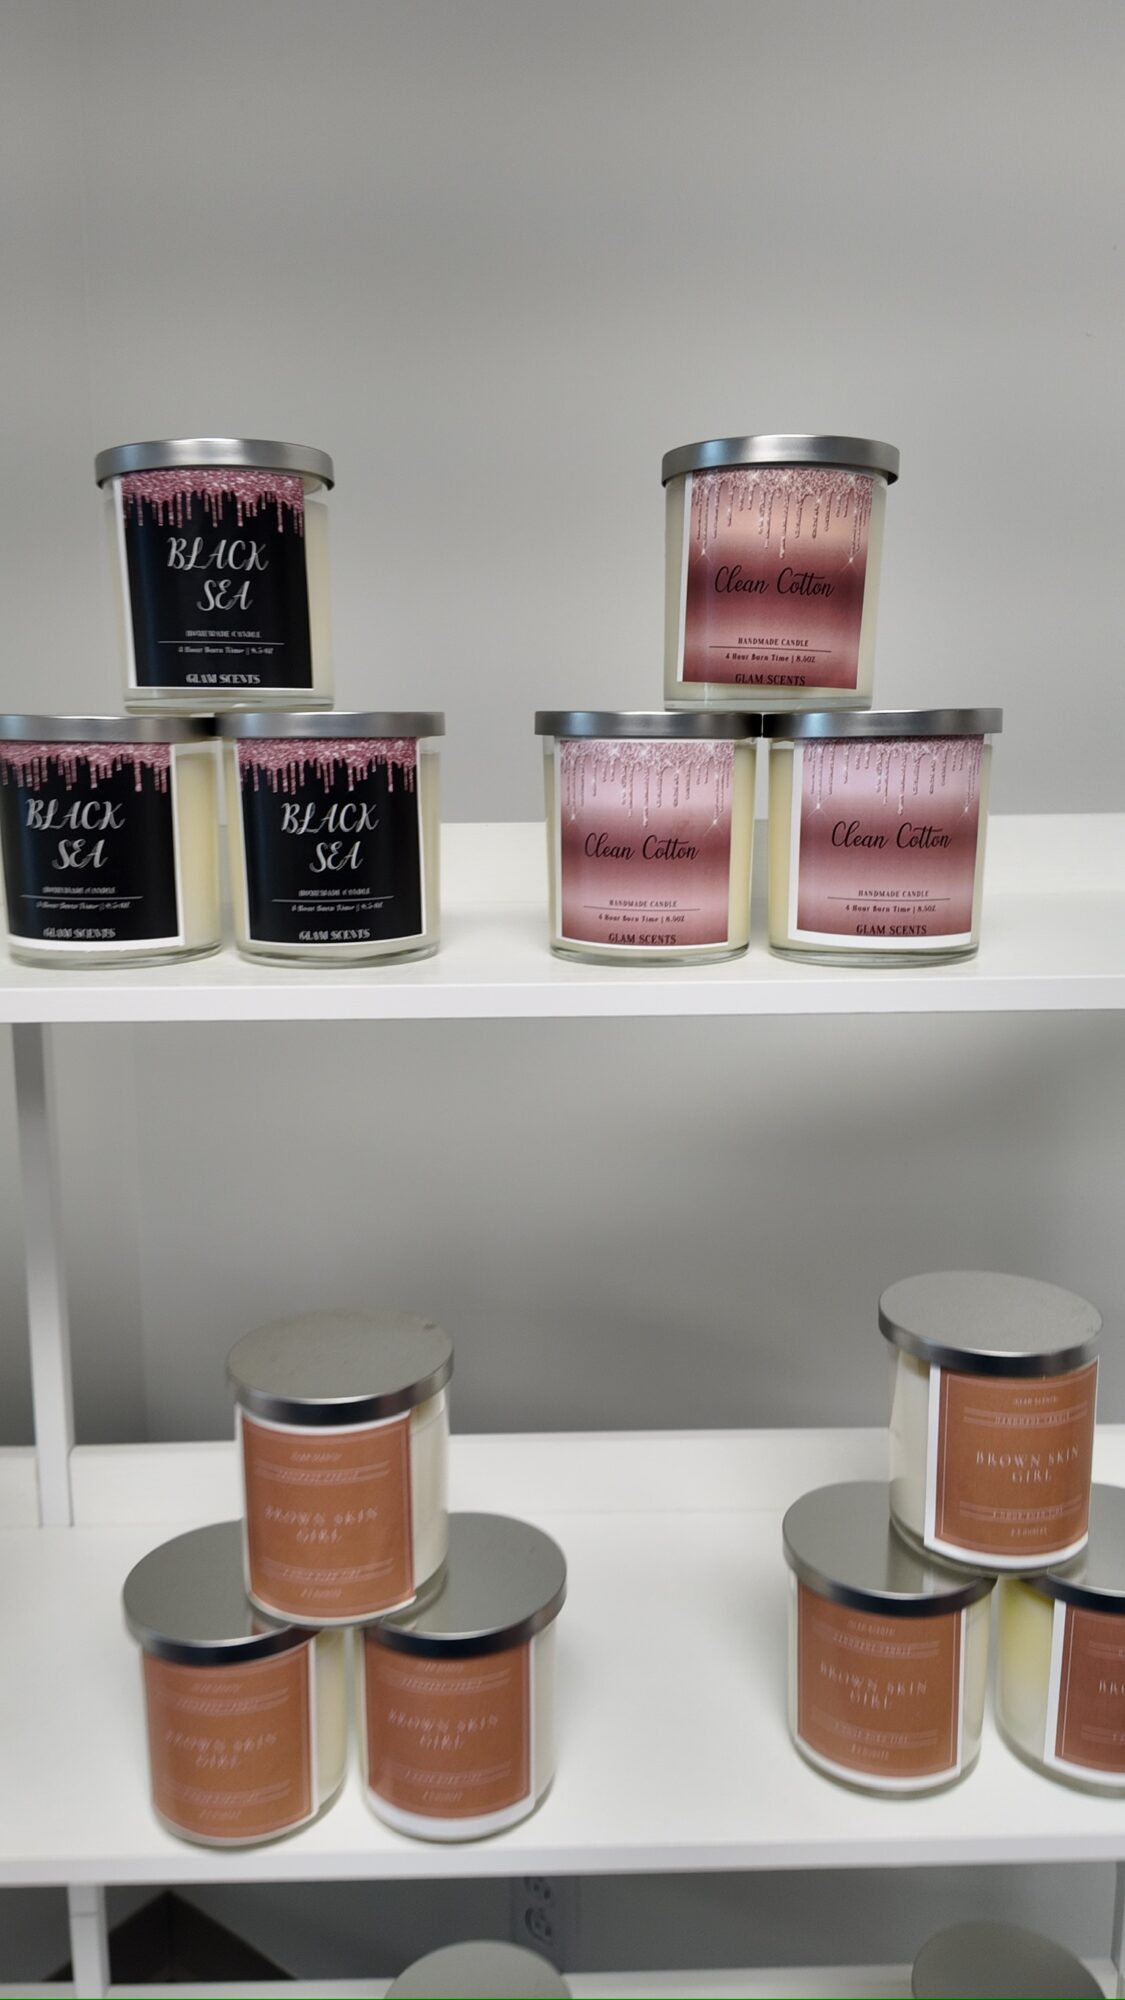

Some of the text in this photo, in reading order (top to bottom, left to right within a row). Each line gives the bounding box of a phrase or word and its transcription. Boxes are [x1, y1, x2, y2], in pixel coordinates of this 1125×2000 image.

[166, 537, 269, 571] BLACK
[714, 565, 835, 597] Clean Cotton
[197, 579, 253, 611] SEA
[738, 637, 809, 647] HANDMADE CANDLE
[732, 653, 749, 661] Hour
[771, 654, 789, 662] Time
[185, 673, 261, 684] GLAM SCENTS
[735, 673, 806, 686] GLAM SCENTS
[25, 798, 125, 830] BLACK
[281, 802, 379, 835] BLACK
[831, 820, 952, 849] Clean Cotton
[584, 832, 700, 860] Clean Cotton
[51, 839, 109, 870] SEA
[309, 841, 363, 873] SEA
[858, 890, 929, 898] HANDMADE CANDLE
[609, 899, 678, 908] HANDMADE CANDLE
[852, 904, 870, 912] Hour
[893, 905, 911, 913] Time
[641, 915, 658, 923] Time
[856, 924, 927, 935] GLAM SCENTS
[608, 933, 677, 945] GLAM SCENTS
[976, 1443, 1079, 1468] BROWN SKIN
[1012, 1468, 1052, 1483] GIRL
